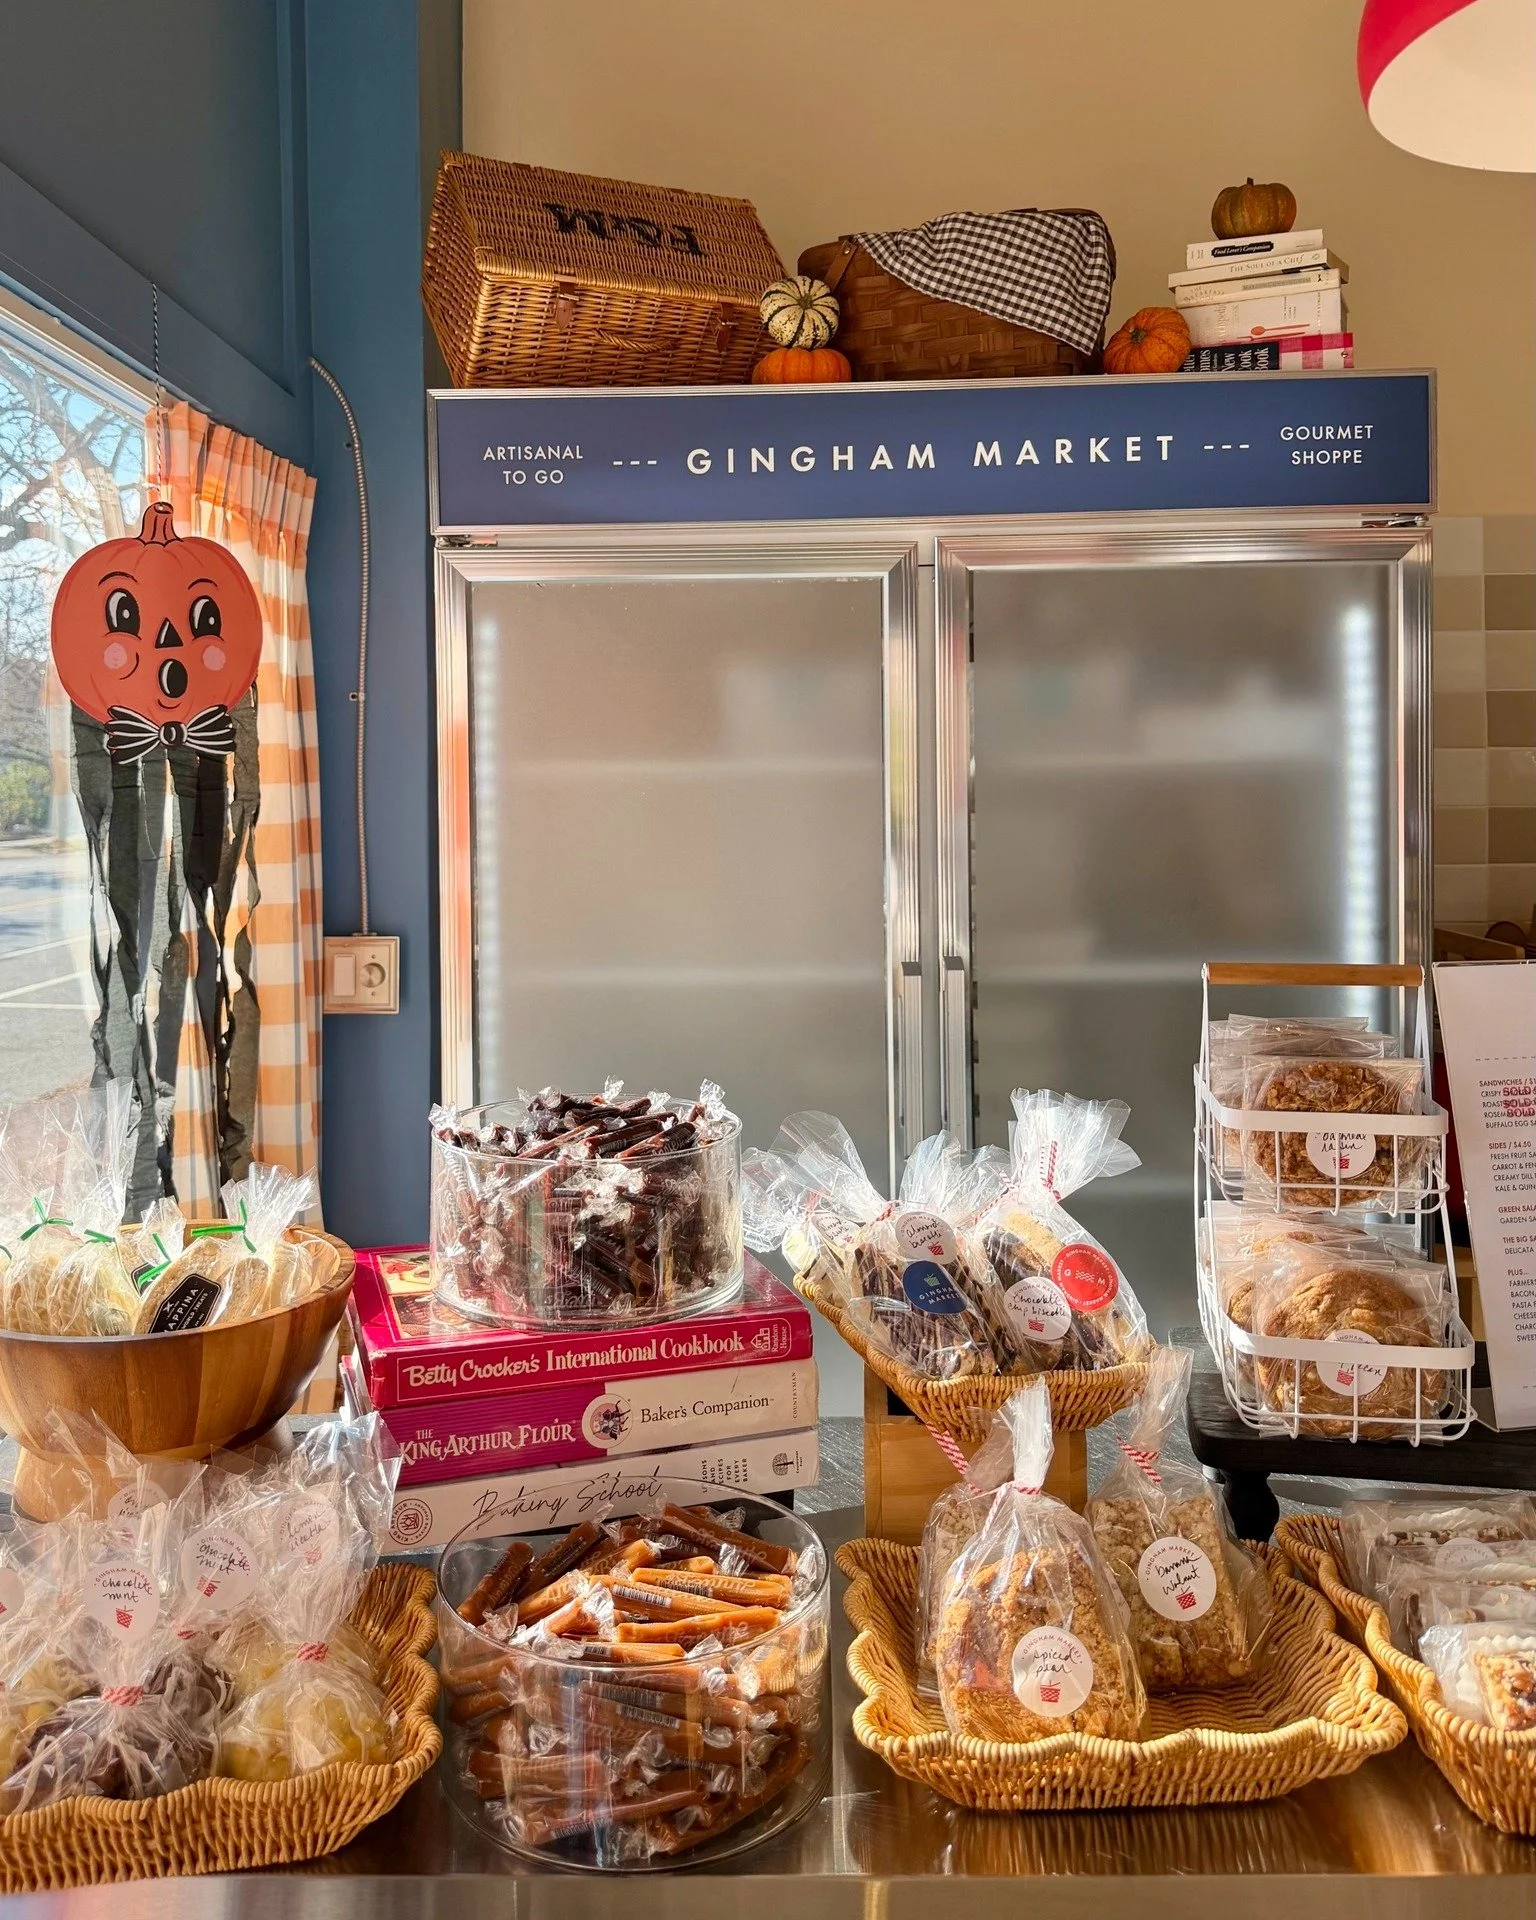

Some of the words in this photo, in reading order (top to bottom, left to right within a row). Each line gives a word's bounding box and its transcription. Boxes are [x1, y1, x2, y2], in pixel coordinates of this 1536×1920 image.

[1243, 244, 1271, 252] Companion
[1284, 254, 1304, 264] CHEF
[1279, 424, 1374, 442] GOURMET
[482, 444, 584, 461] ARTISANAL
[686, 443, 936, 475] GINGHAM
[973, 434, 1174, 467] MARKET
[1291, 448, 1363, 466] SHOPPE
[503, 470, 526, 485] TO
[535, 469, 564, 485] GO
[1479, 1079, 1522, 1087] SANDWICHES
[1503, 1086, 1531, 1096] SOLD
[1503, 1098, 1531, 1108] SOLD
[1322, 1142, 1363, 1152] rasin
[1516, 1235, 1527, 1243] BIG
[918, 1286, 956, 1300] GINGHA
[194, 1292, 209, 1311] TREATS
[1512, 1301, 1532, 1309] PASTA
[770, 1323, 779, 1353] Random
[780, 1325, 788, 1350] House
[402, 1363, 457, 1387] Betty
[459, 1353, 541, 1382] Crocker's
[546, 1338, 658, 1372] International
[660, 1330, 745, 1358] Cookbook
[641, 1405, 688, 1424] Baker's
[692, 1394, 770, 1416] Companion
[399, 1439, 443, 1466] KING
[440, 1429, 518, 1462] ARTHUR
[516, 1419, 577, 1449] FLOUR
[415, 1429, 433, 1441] THE
[473, 1485, 569, 1531] Baking
[576, 1465, 662, 1513] School
[391, 1503, 408, 1529] ARTHUR
[201, 1536, 235, 1547] GINGHAM
[392, 1530, 408, 1542] KING
[1145, 1547, 1167, 1576] GINGHAM
[1168, 1545, 1195, 1557] MARKET
[95, 1567, 127, 1583] GINGHAM
[1023, 1634, 1055, 1655] GINGHAM
[1057, 1636, 1082, 1659] MARKET
